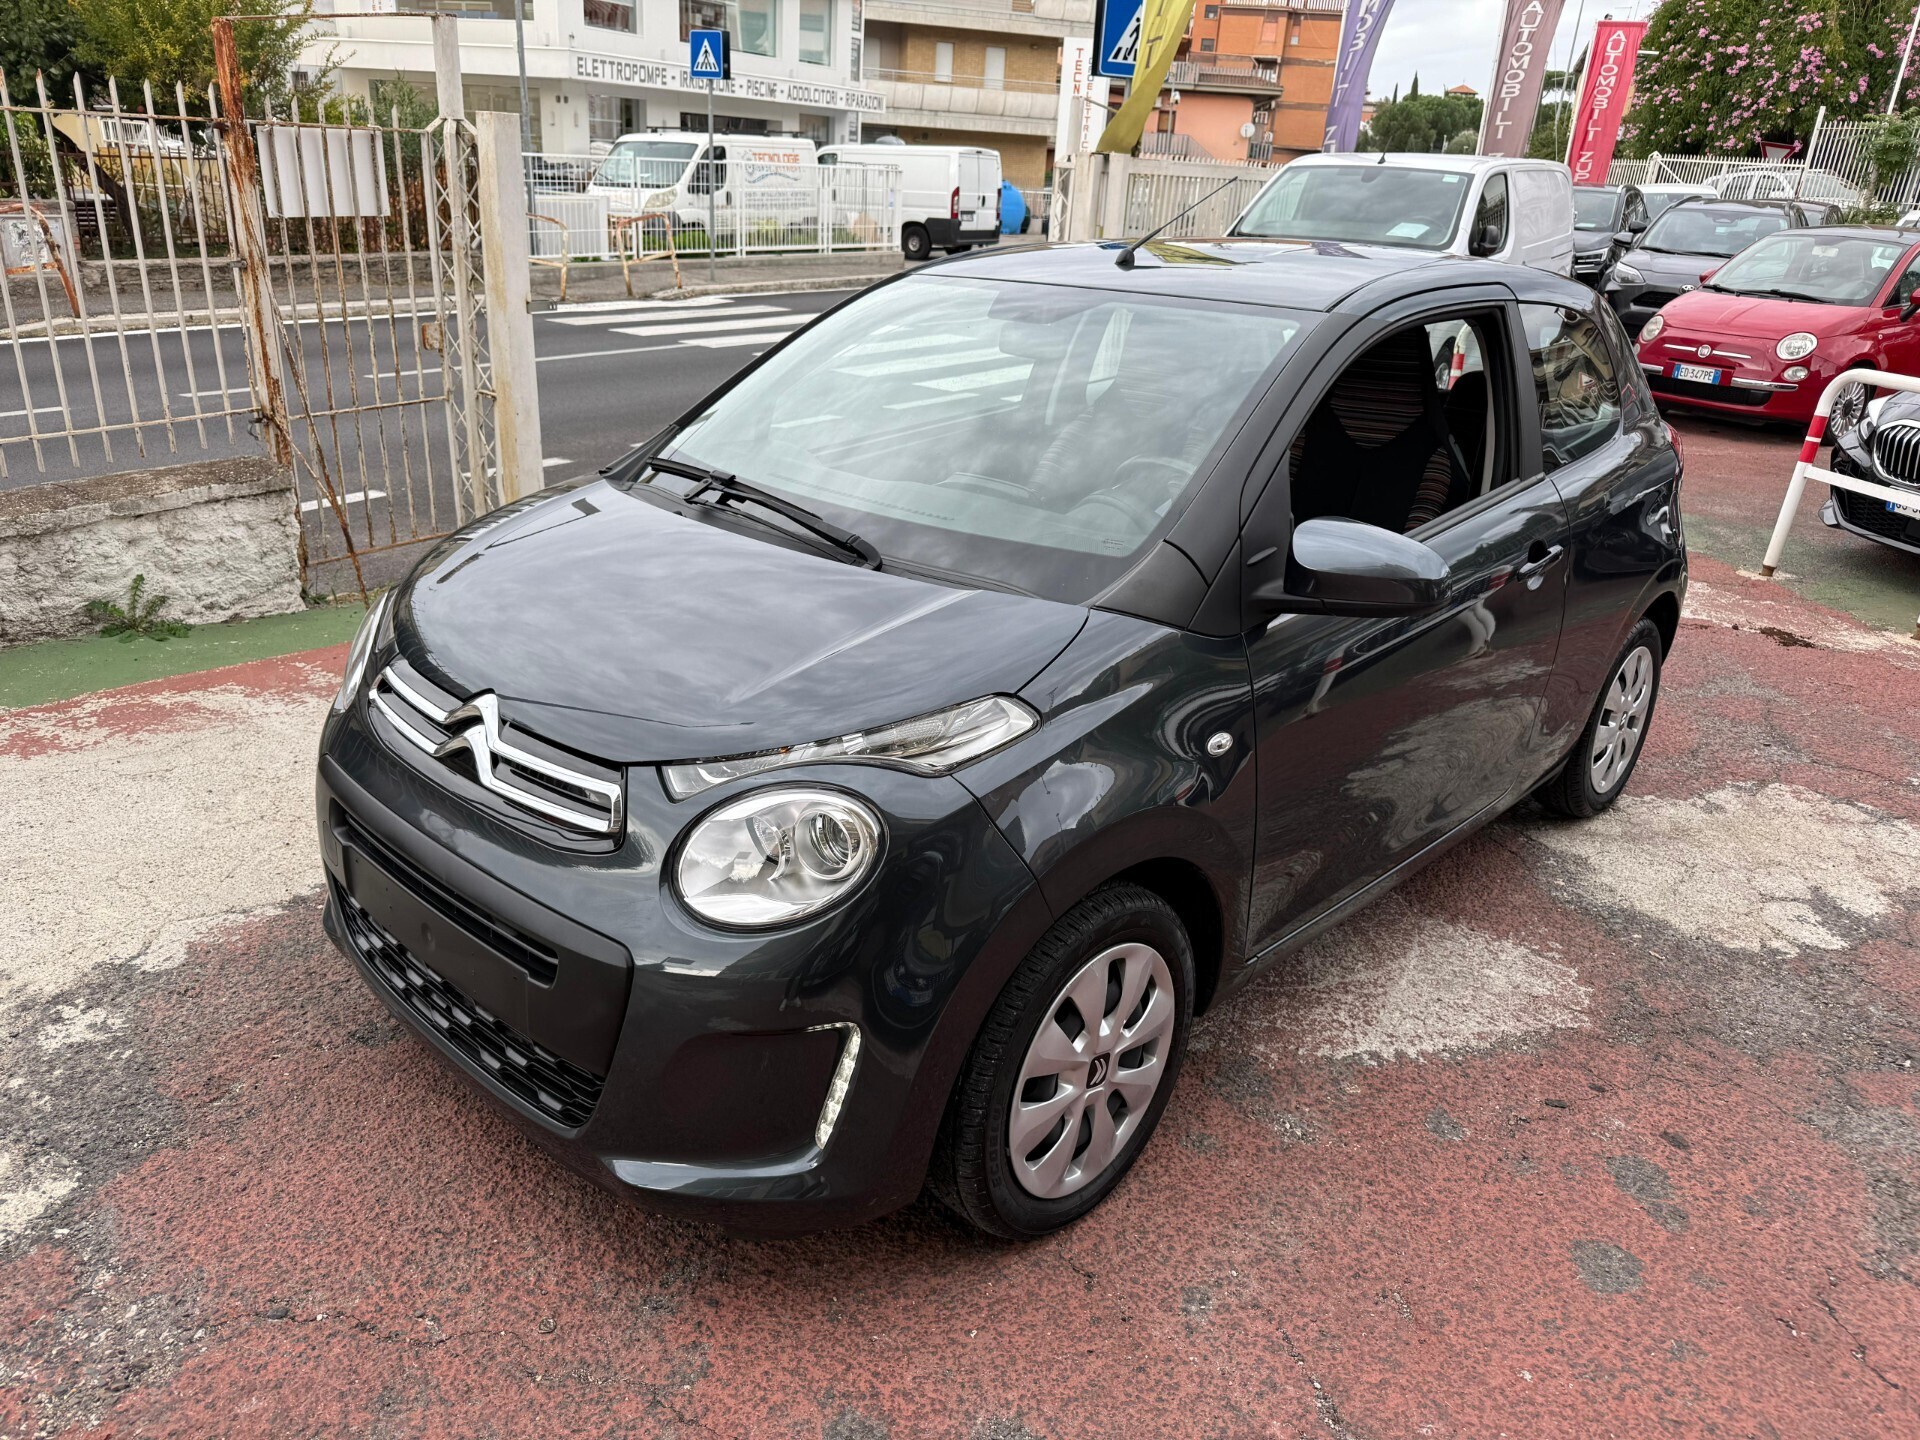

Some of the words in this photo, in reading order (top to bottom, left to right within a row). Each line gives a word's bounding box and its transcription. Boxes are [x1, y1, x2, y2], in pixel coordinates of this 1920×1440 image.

[577, 56, 667, 86] ELETTROPOMPE
[787, 84, 837, 105] ADDOLCITORI
[844, 92, 884, 111] RIPARAZIONI
[1495, 1, 1545, 139] AUTOMOBILI
[1586, 30, 1627, 141] AUTOMOBILI
[1573, 151, 1595, 182] ZUP
